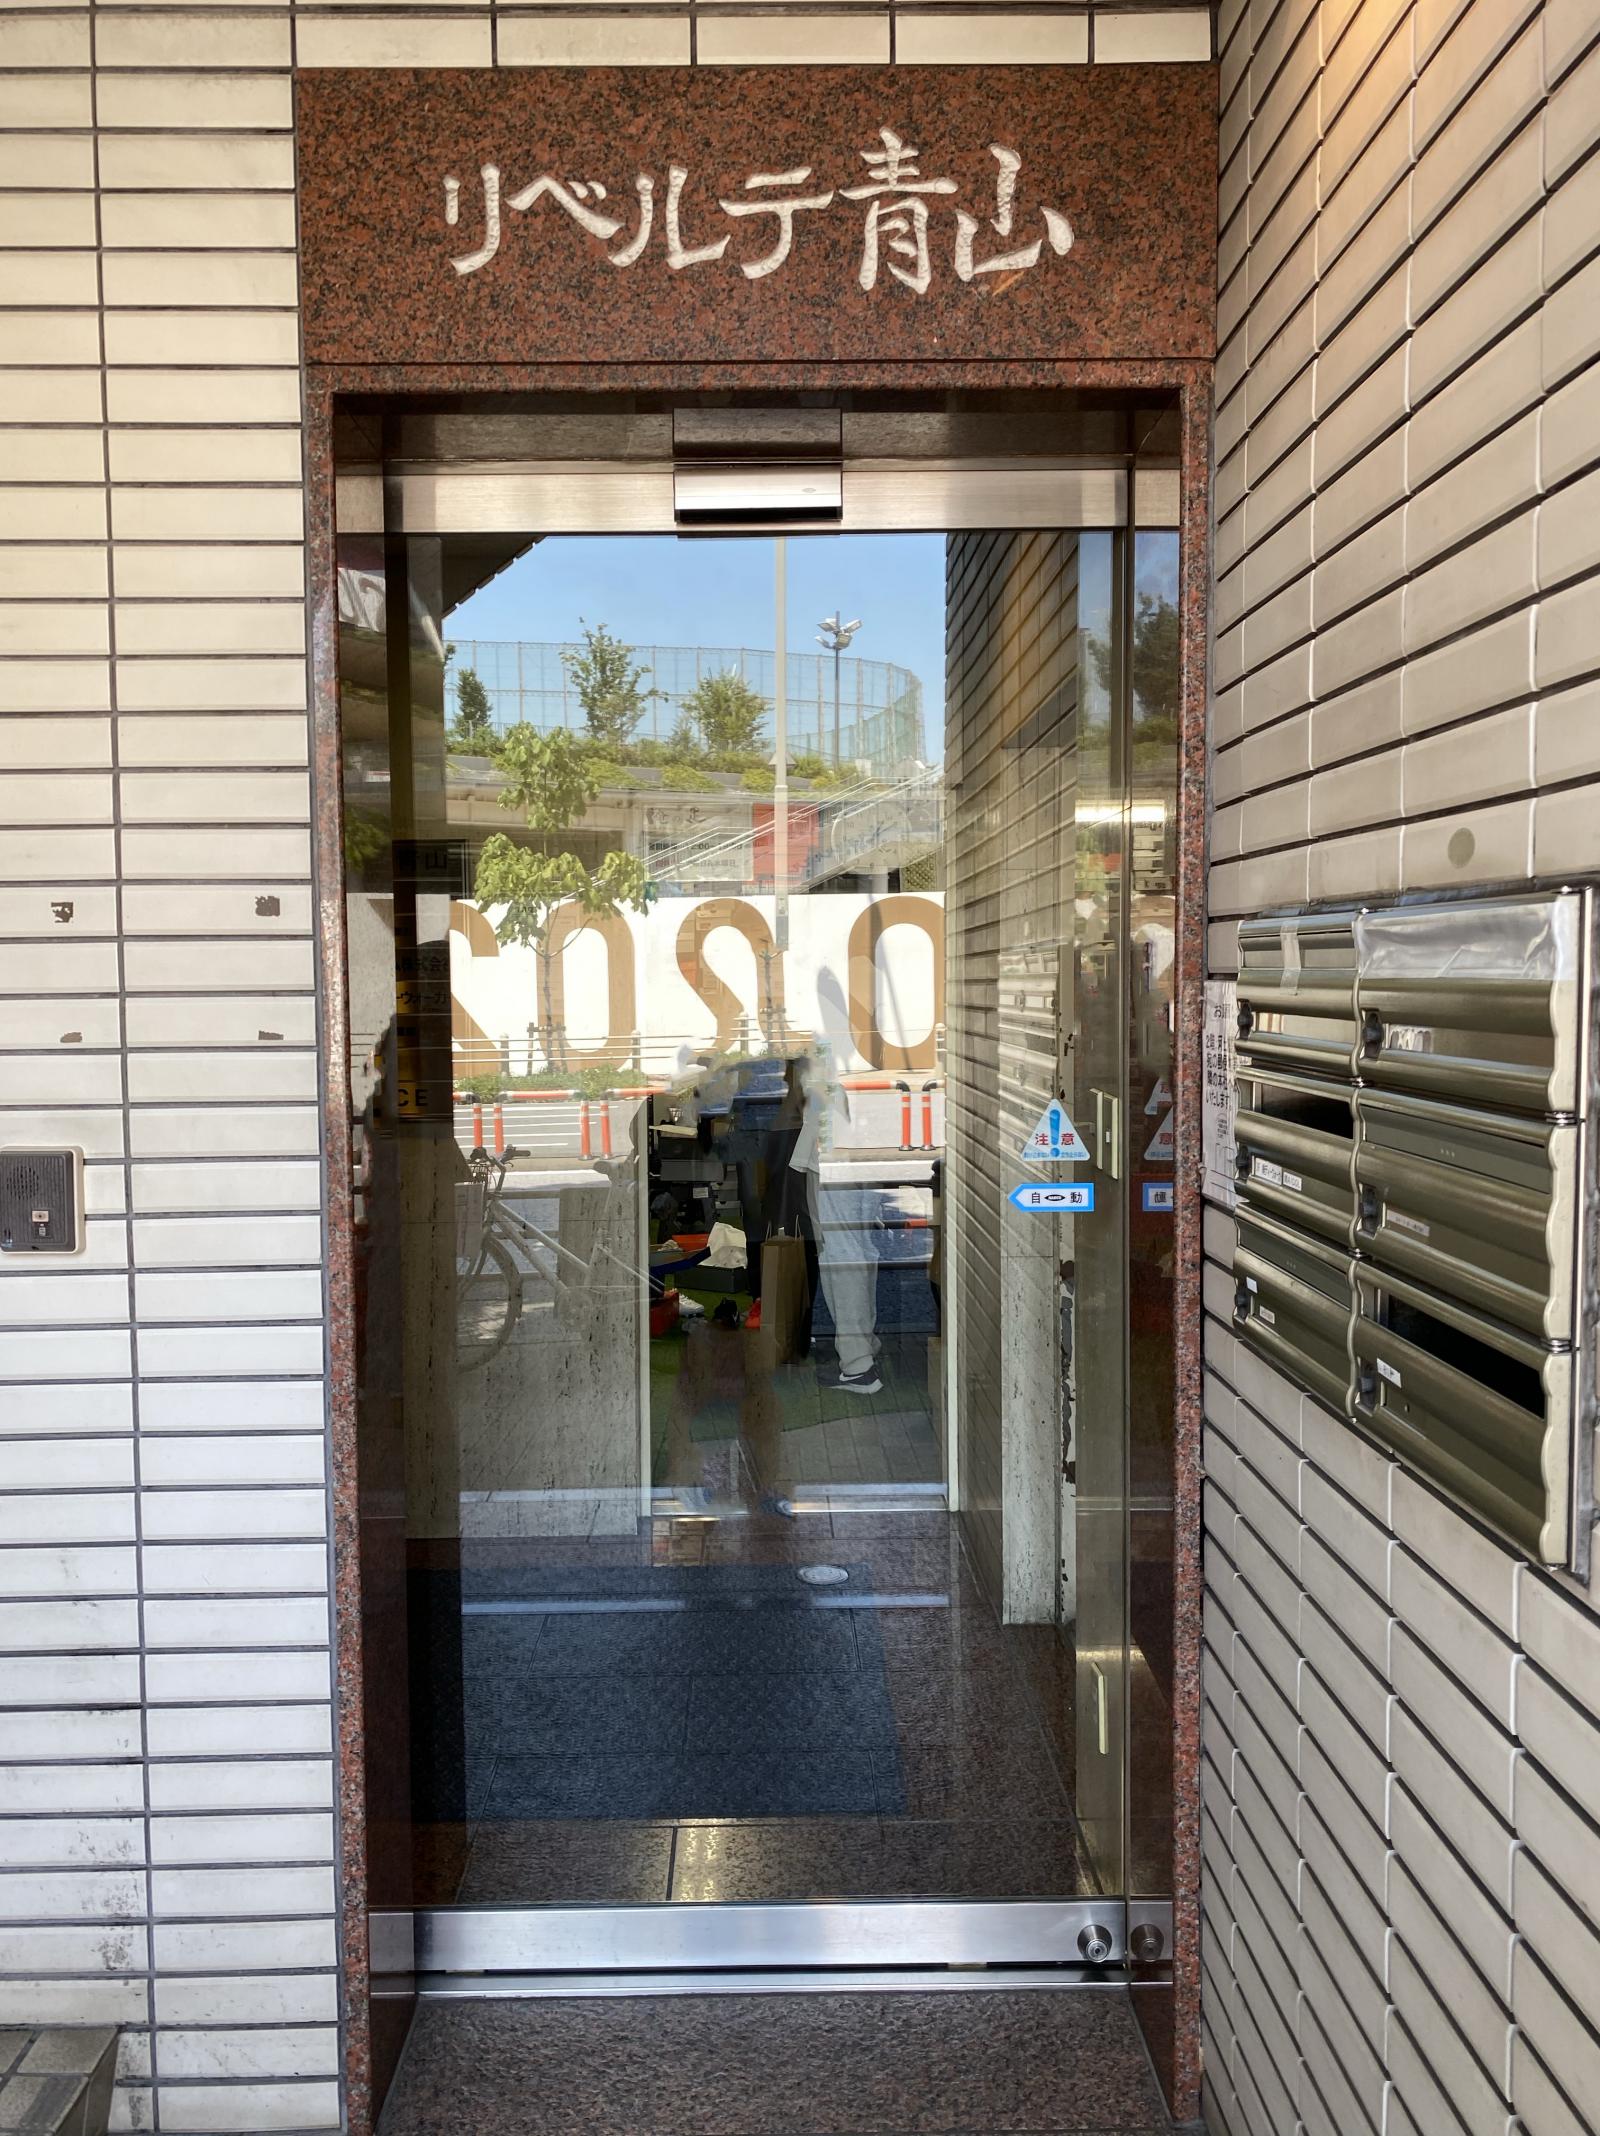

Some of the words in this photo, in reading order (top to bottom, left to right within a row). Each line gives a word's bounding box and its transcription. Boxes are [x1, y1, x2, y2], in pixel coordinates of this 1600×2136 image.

[443, 127, 1075, 294] リベルテ青山
